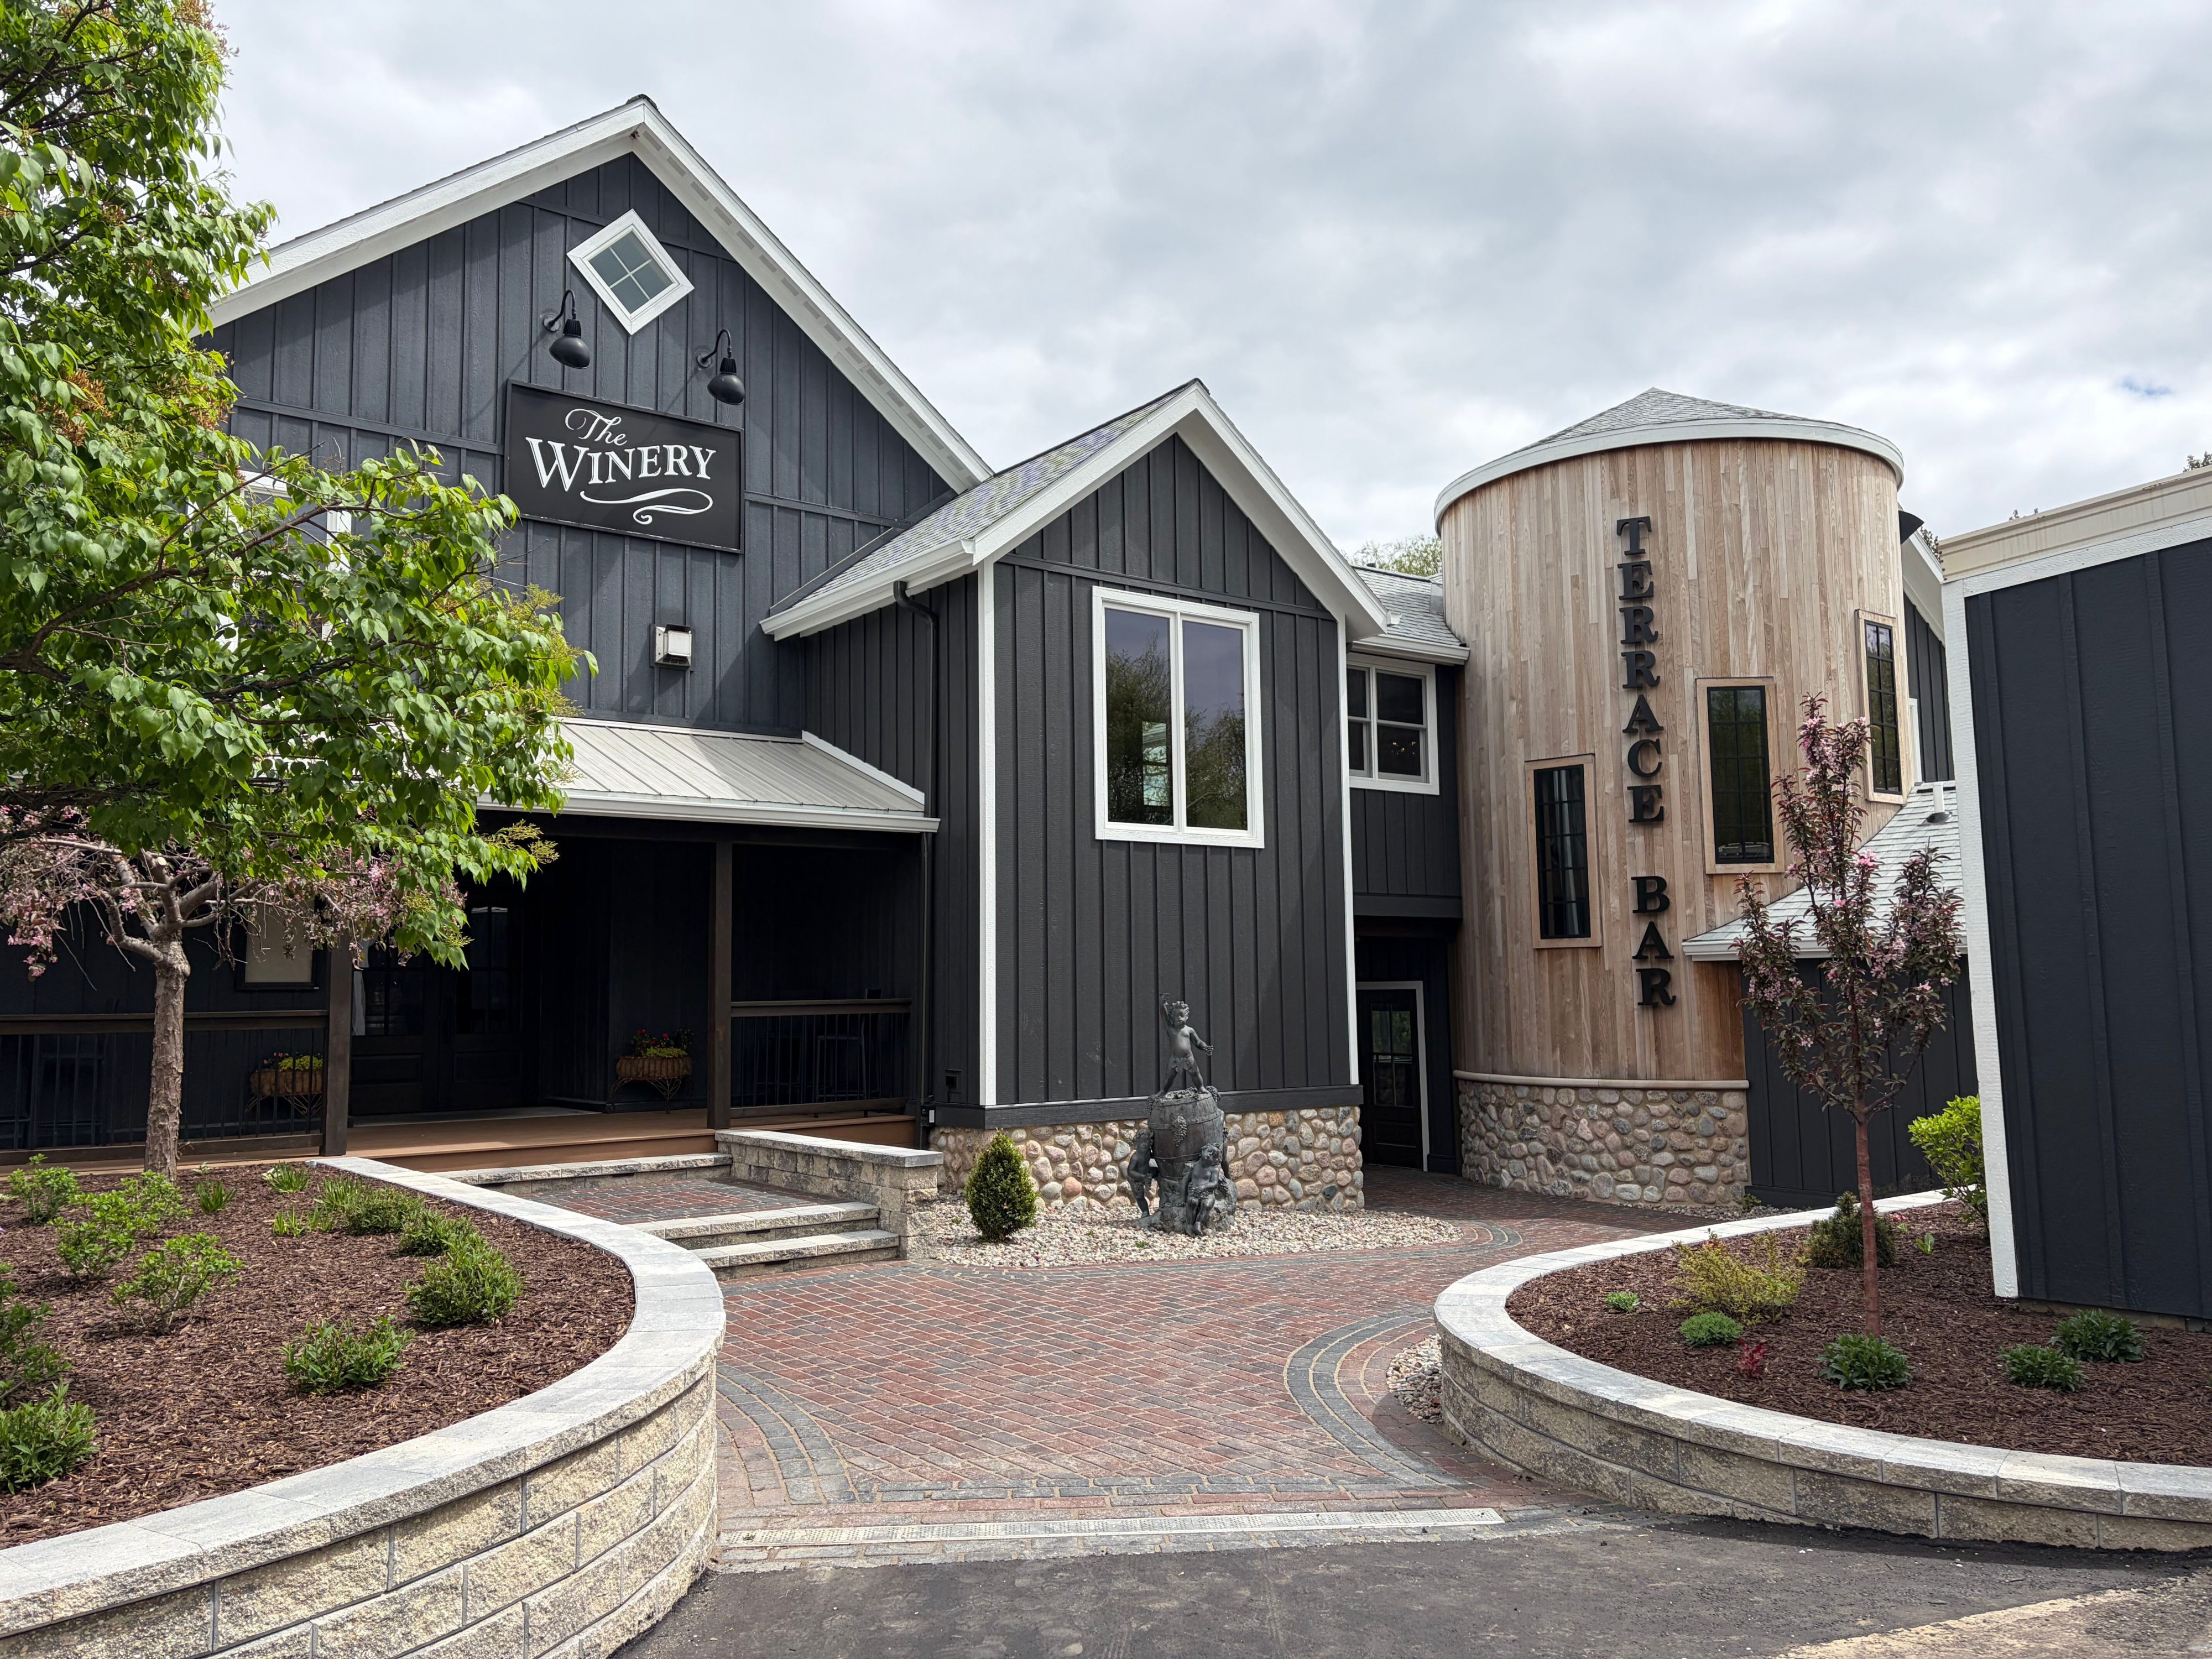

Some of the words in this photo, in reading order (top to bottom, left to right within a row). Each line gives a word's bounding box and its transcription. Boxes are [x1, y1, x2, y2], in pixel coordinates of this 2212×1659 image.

[525, 437, 716, 492] WINERY
[565, 408, 628, 446] The
[1616, 515, 1664, 823] TERRACE
[1631, 876, 1677, 1006] BAR
